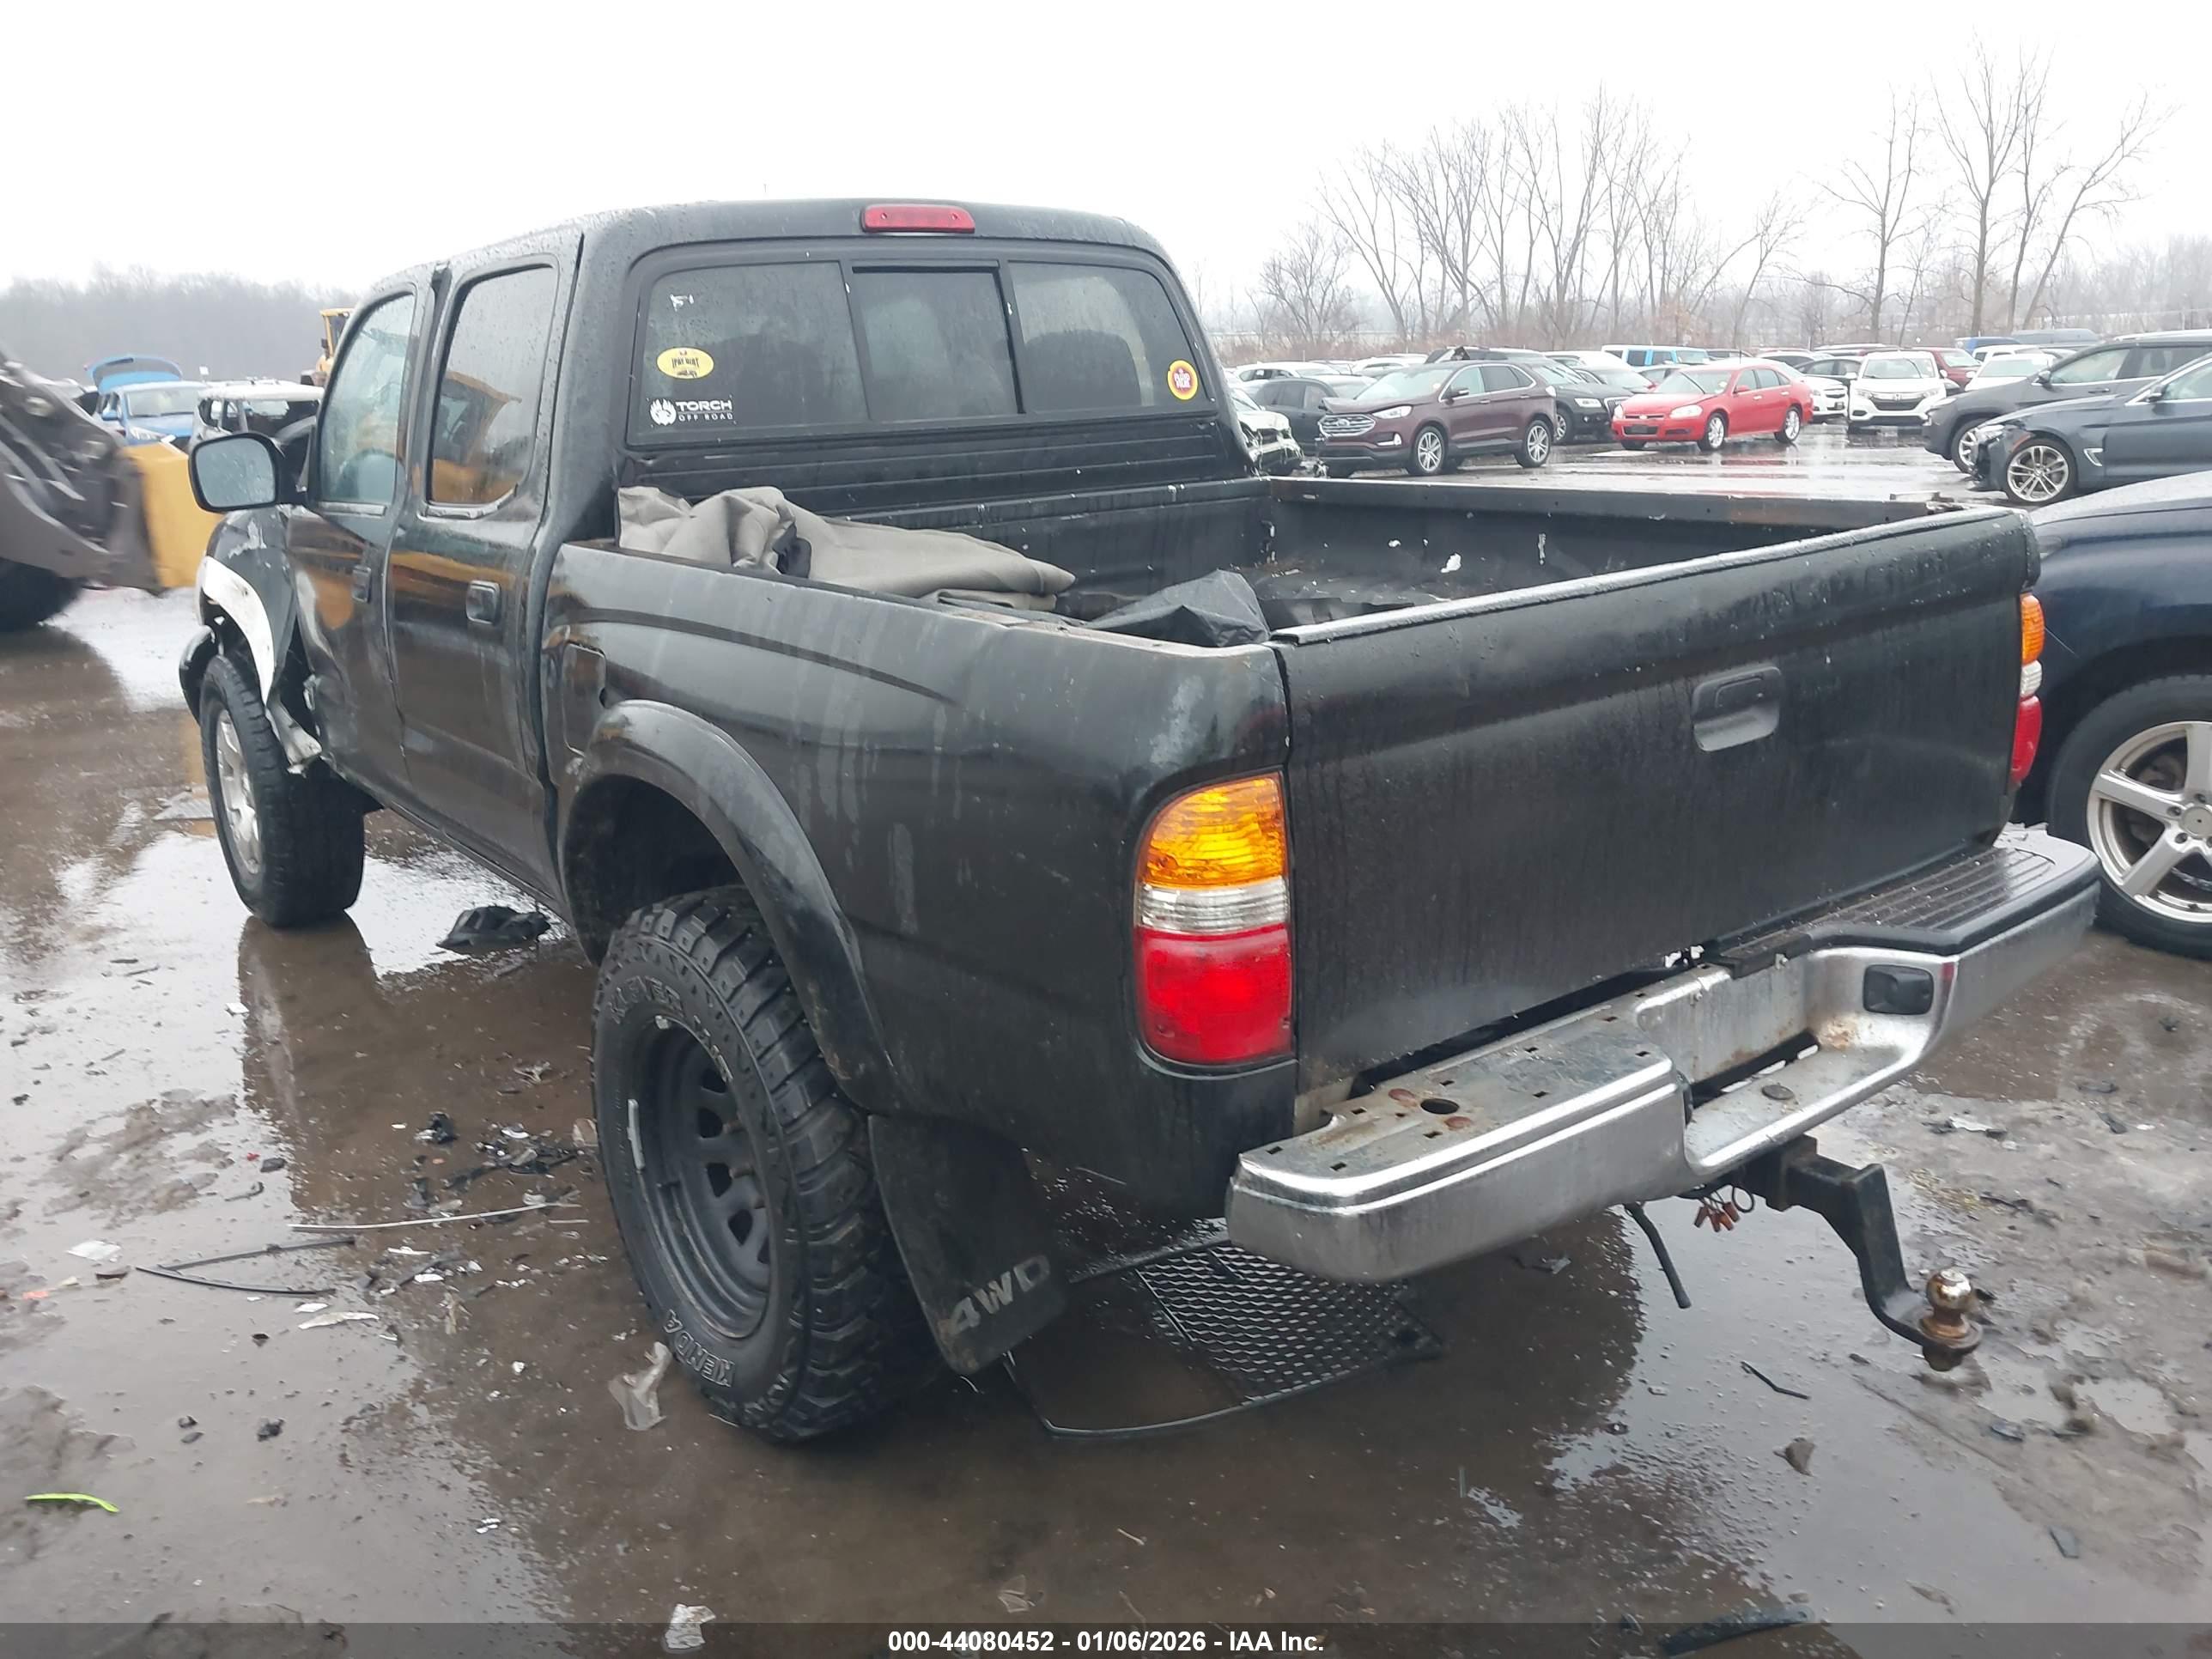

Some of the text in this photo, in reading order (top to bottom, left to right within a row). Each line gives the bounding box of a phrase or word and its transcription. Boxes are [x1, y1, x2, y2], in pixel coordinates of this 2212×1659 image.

[675, 399, 732, 412] TORCH
[678, 412, 733, 422] OFF ROAD
[937, 1255, 1050, 1335] 4WD
[662, 1308, 735, 1388] KENDA
